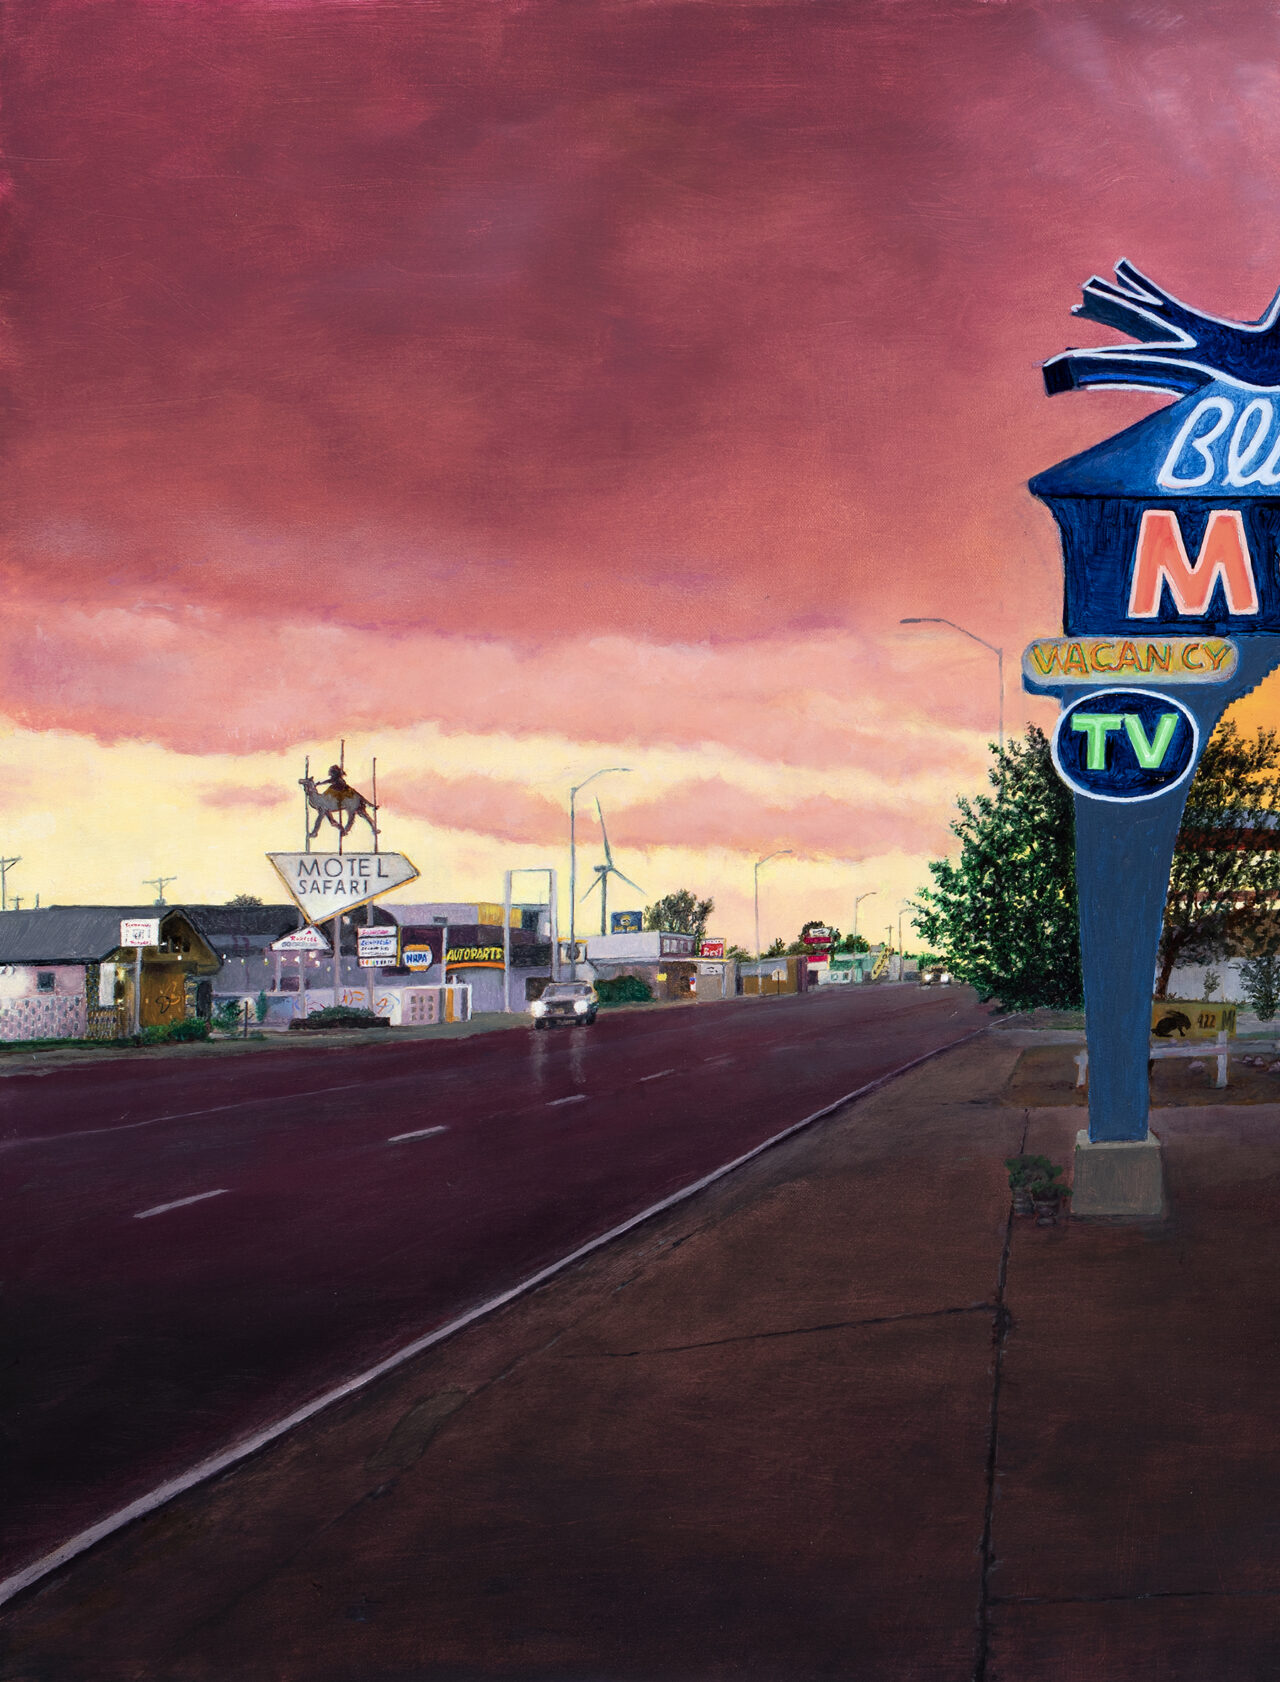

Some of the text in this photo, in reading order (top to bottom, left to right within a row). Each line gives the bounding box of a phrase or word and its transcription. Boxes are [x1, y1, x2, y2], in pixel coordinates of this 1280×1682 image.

[1032, 641, 1232, 675] VACANCY
[1070, 712, 1180, 771] TV
[297, 857, 390, 879] MOTEL
[297, 879, 369, 896] SAFARI
